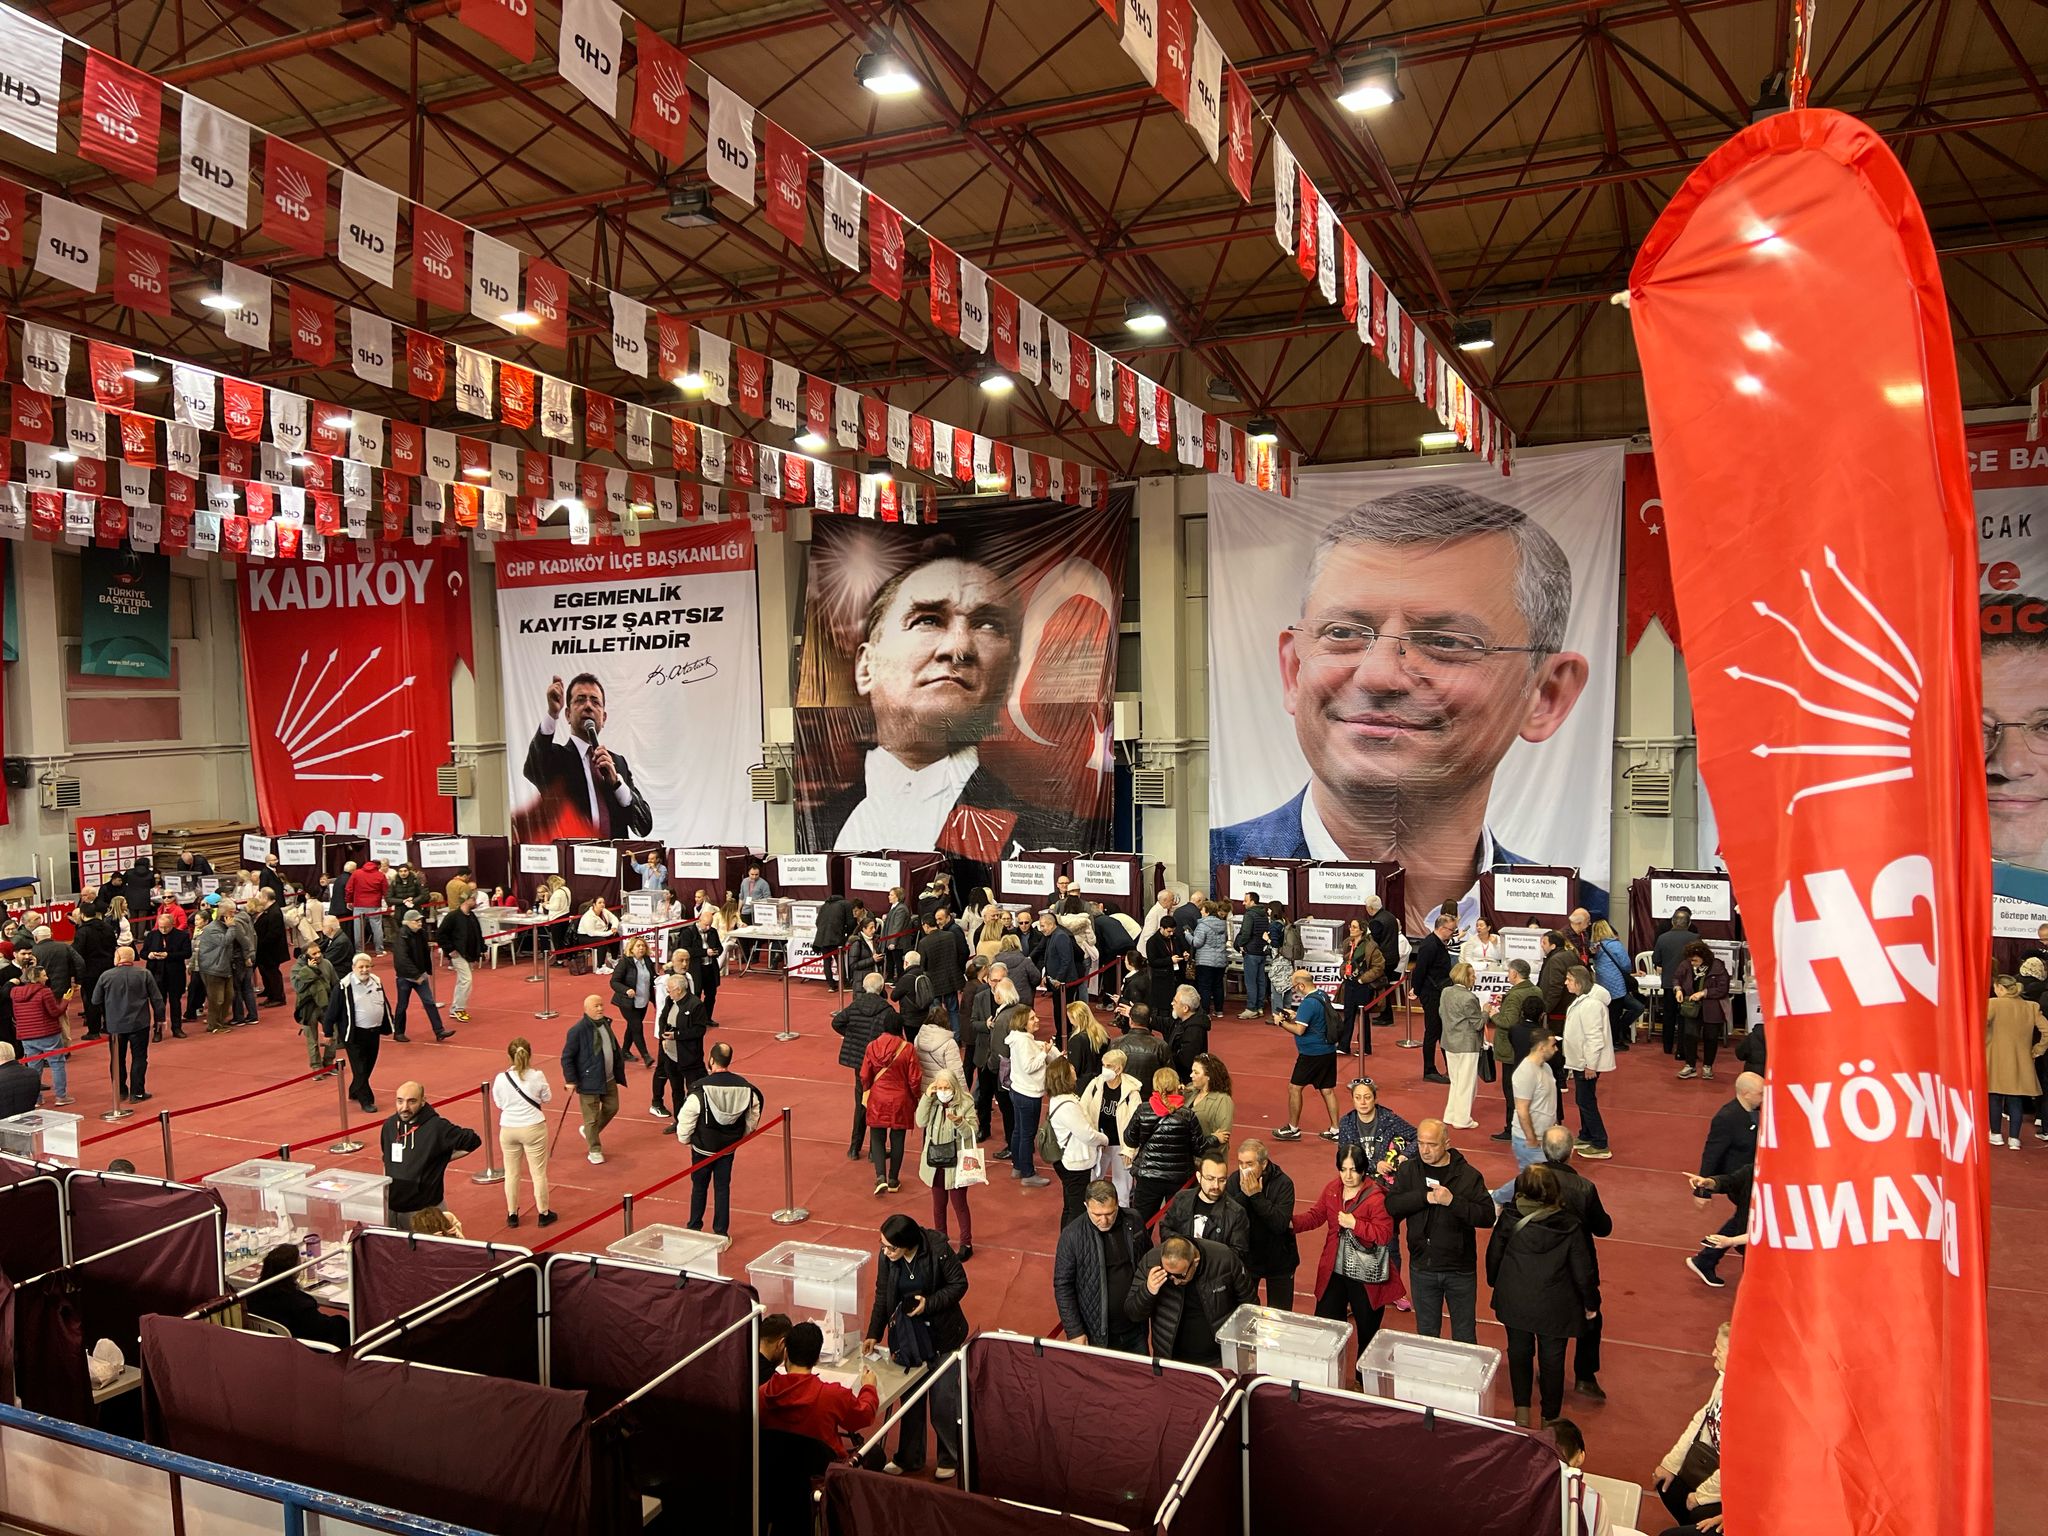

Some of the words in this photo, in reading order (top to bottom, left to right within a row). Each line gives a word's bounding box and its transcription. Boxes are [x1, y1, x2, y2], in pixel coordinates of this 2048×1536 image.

[506, 561, 535, 578] CHP
[540, 555, 605, 575] KADIKÖY
[609, 550, 643, 573] İLÇE
[647, 539, 744, 569] BAŞKANLIĞI
[107, 587, 146, 599] TÜRKİYE
[553, 583, 682, 609] EGEMENLİK
[99, 595, 152, 608] BASKETBOL
[520, 614, 617, 634] KAYITSIZ
[622, 606, 724, 632] ŞARTSIZ
[551, 630, 691, 655] MİLLETİNDİR
[1506, 890, 1540, 900] Fenerbahçe
[1540, 891, 1555, 899] Mah.
[1665, 894, 1696, 904] Feneryolu
[1697, 895, 1712, 903] Mah.
[1691, 908, 1717, 916] duman
[2000, 911, 2029, 920] Göztepe
